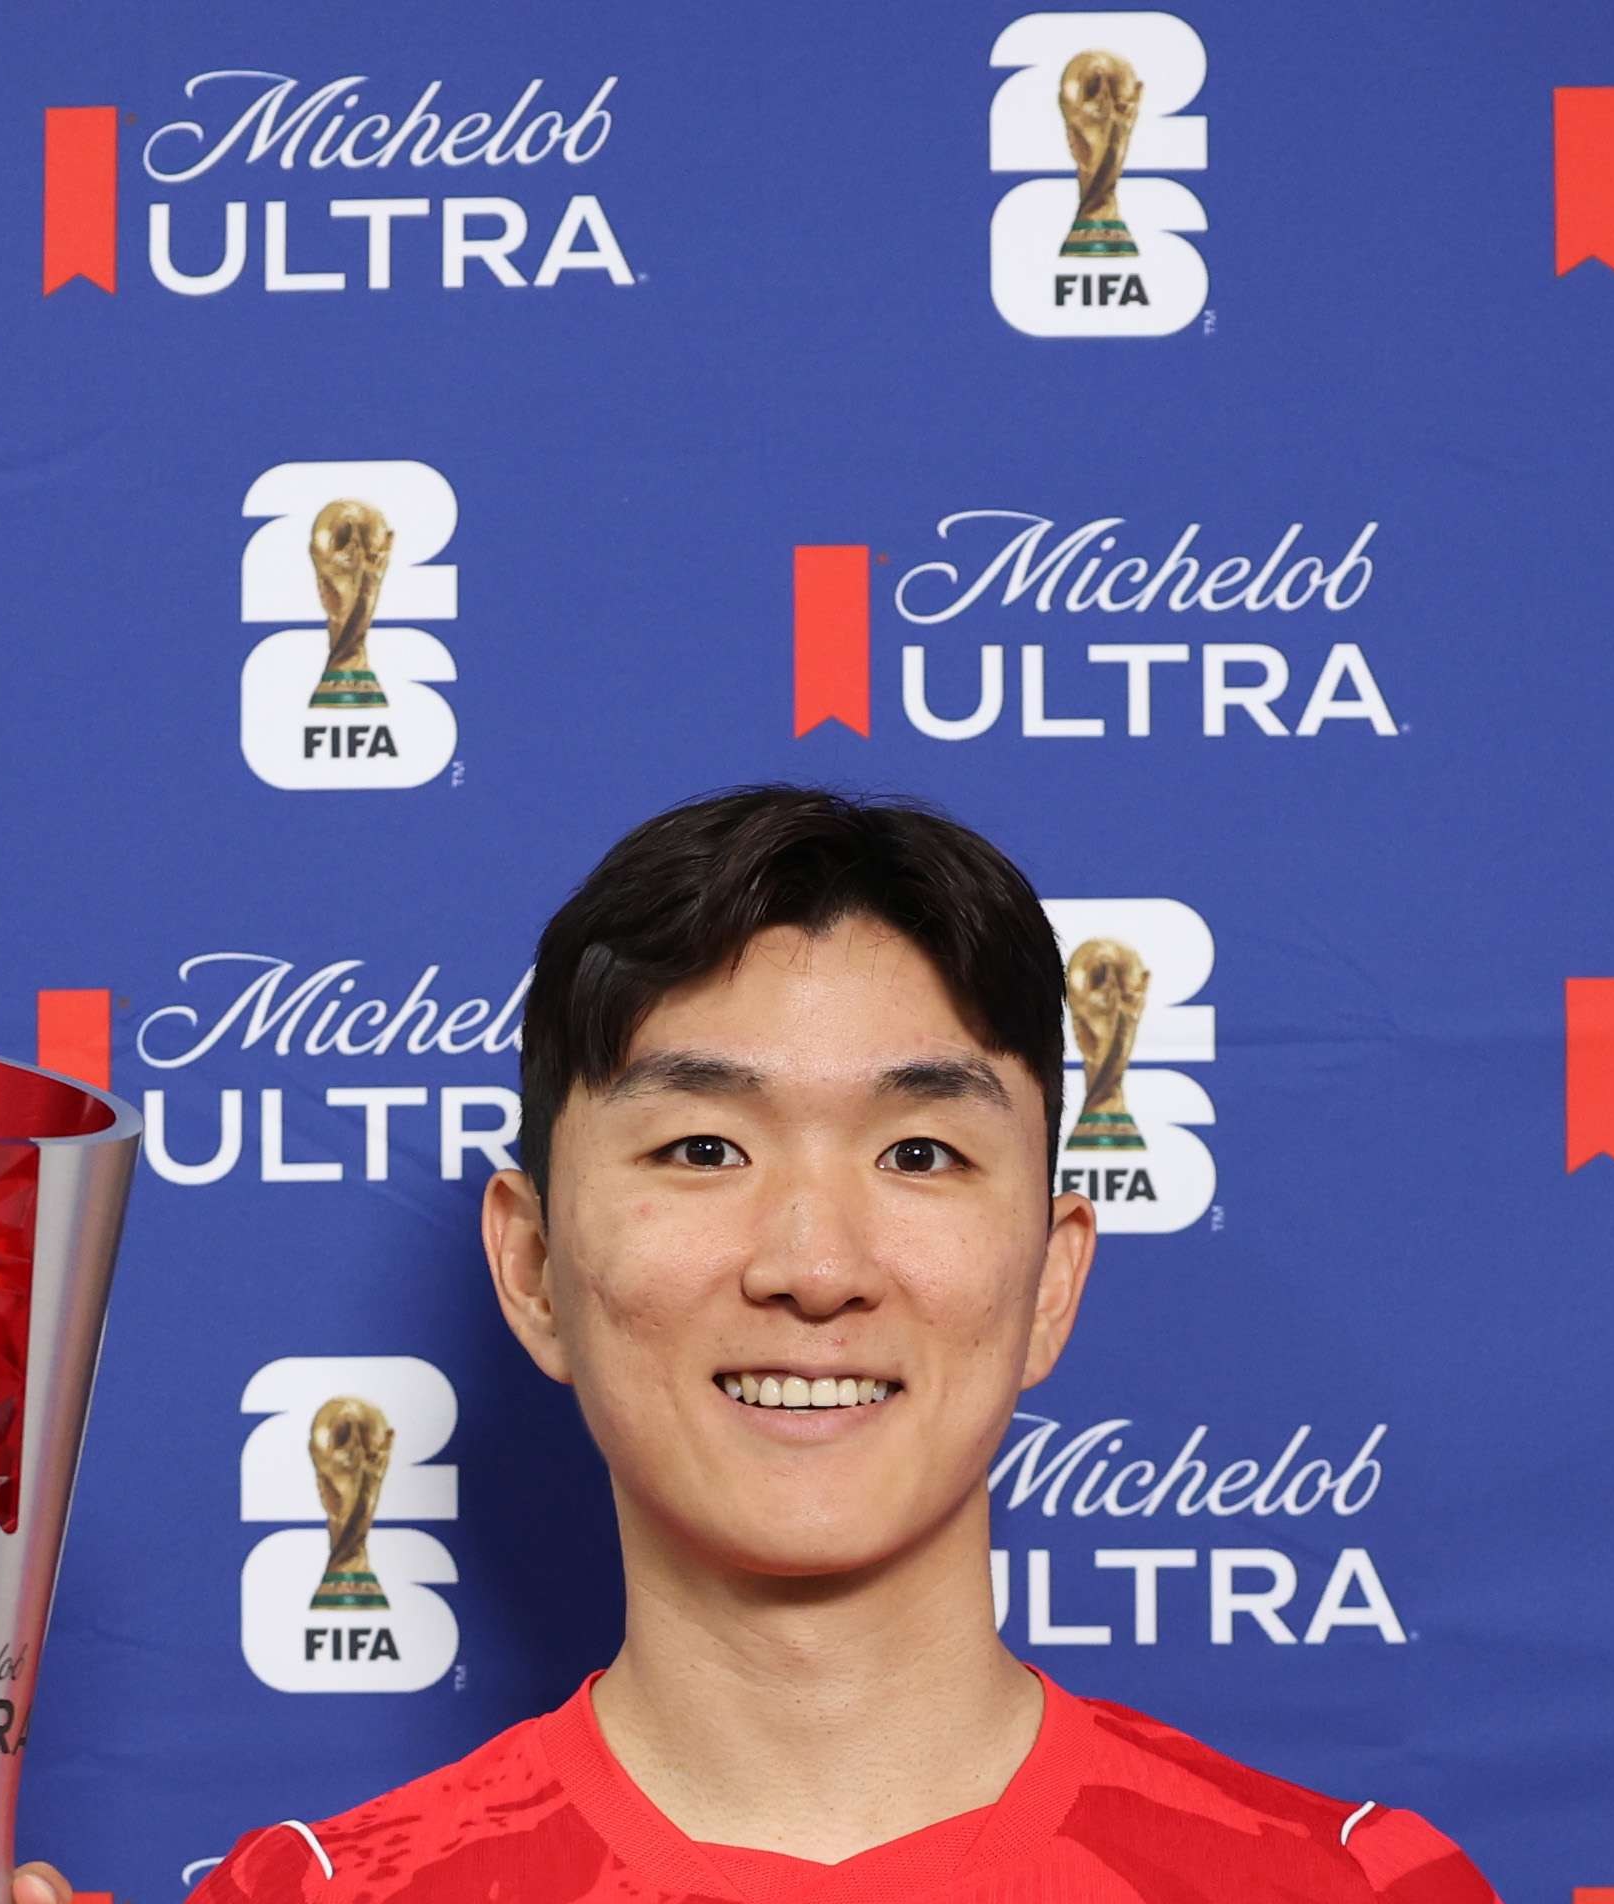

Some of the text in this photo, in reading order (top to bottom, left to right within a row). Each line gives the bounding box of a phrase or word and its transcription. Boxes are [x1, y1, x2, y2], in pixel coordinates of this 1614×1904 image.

[143, 70, 619, 183] Michelob
[148, 195, 636, 297] ULTRA
[1055, 274, 1149, 307] FIFA
[894, 509, 1379, 625] Michelob
[304, 725, 398, 759] FIFA
[902, 643, 1399, 741] ULTRA
[136, 952, 535, 1069] Michel
[143, 1085, 521, 1186] ULTR
[305, 1628, 400, 1661] FIFA
